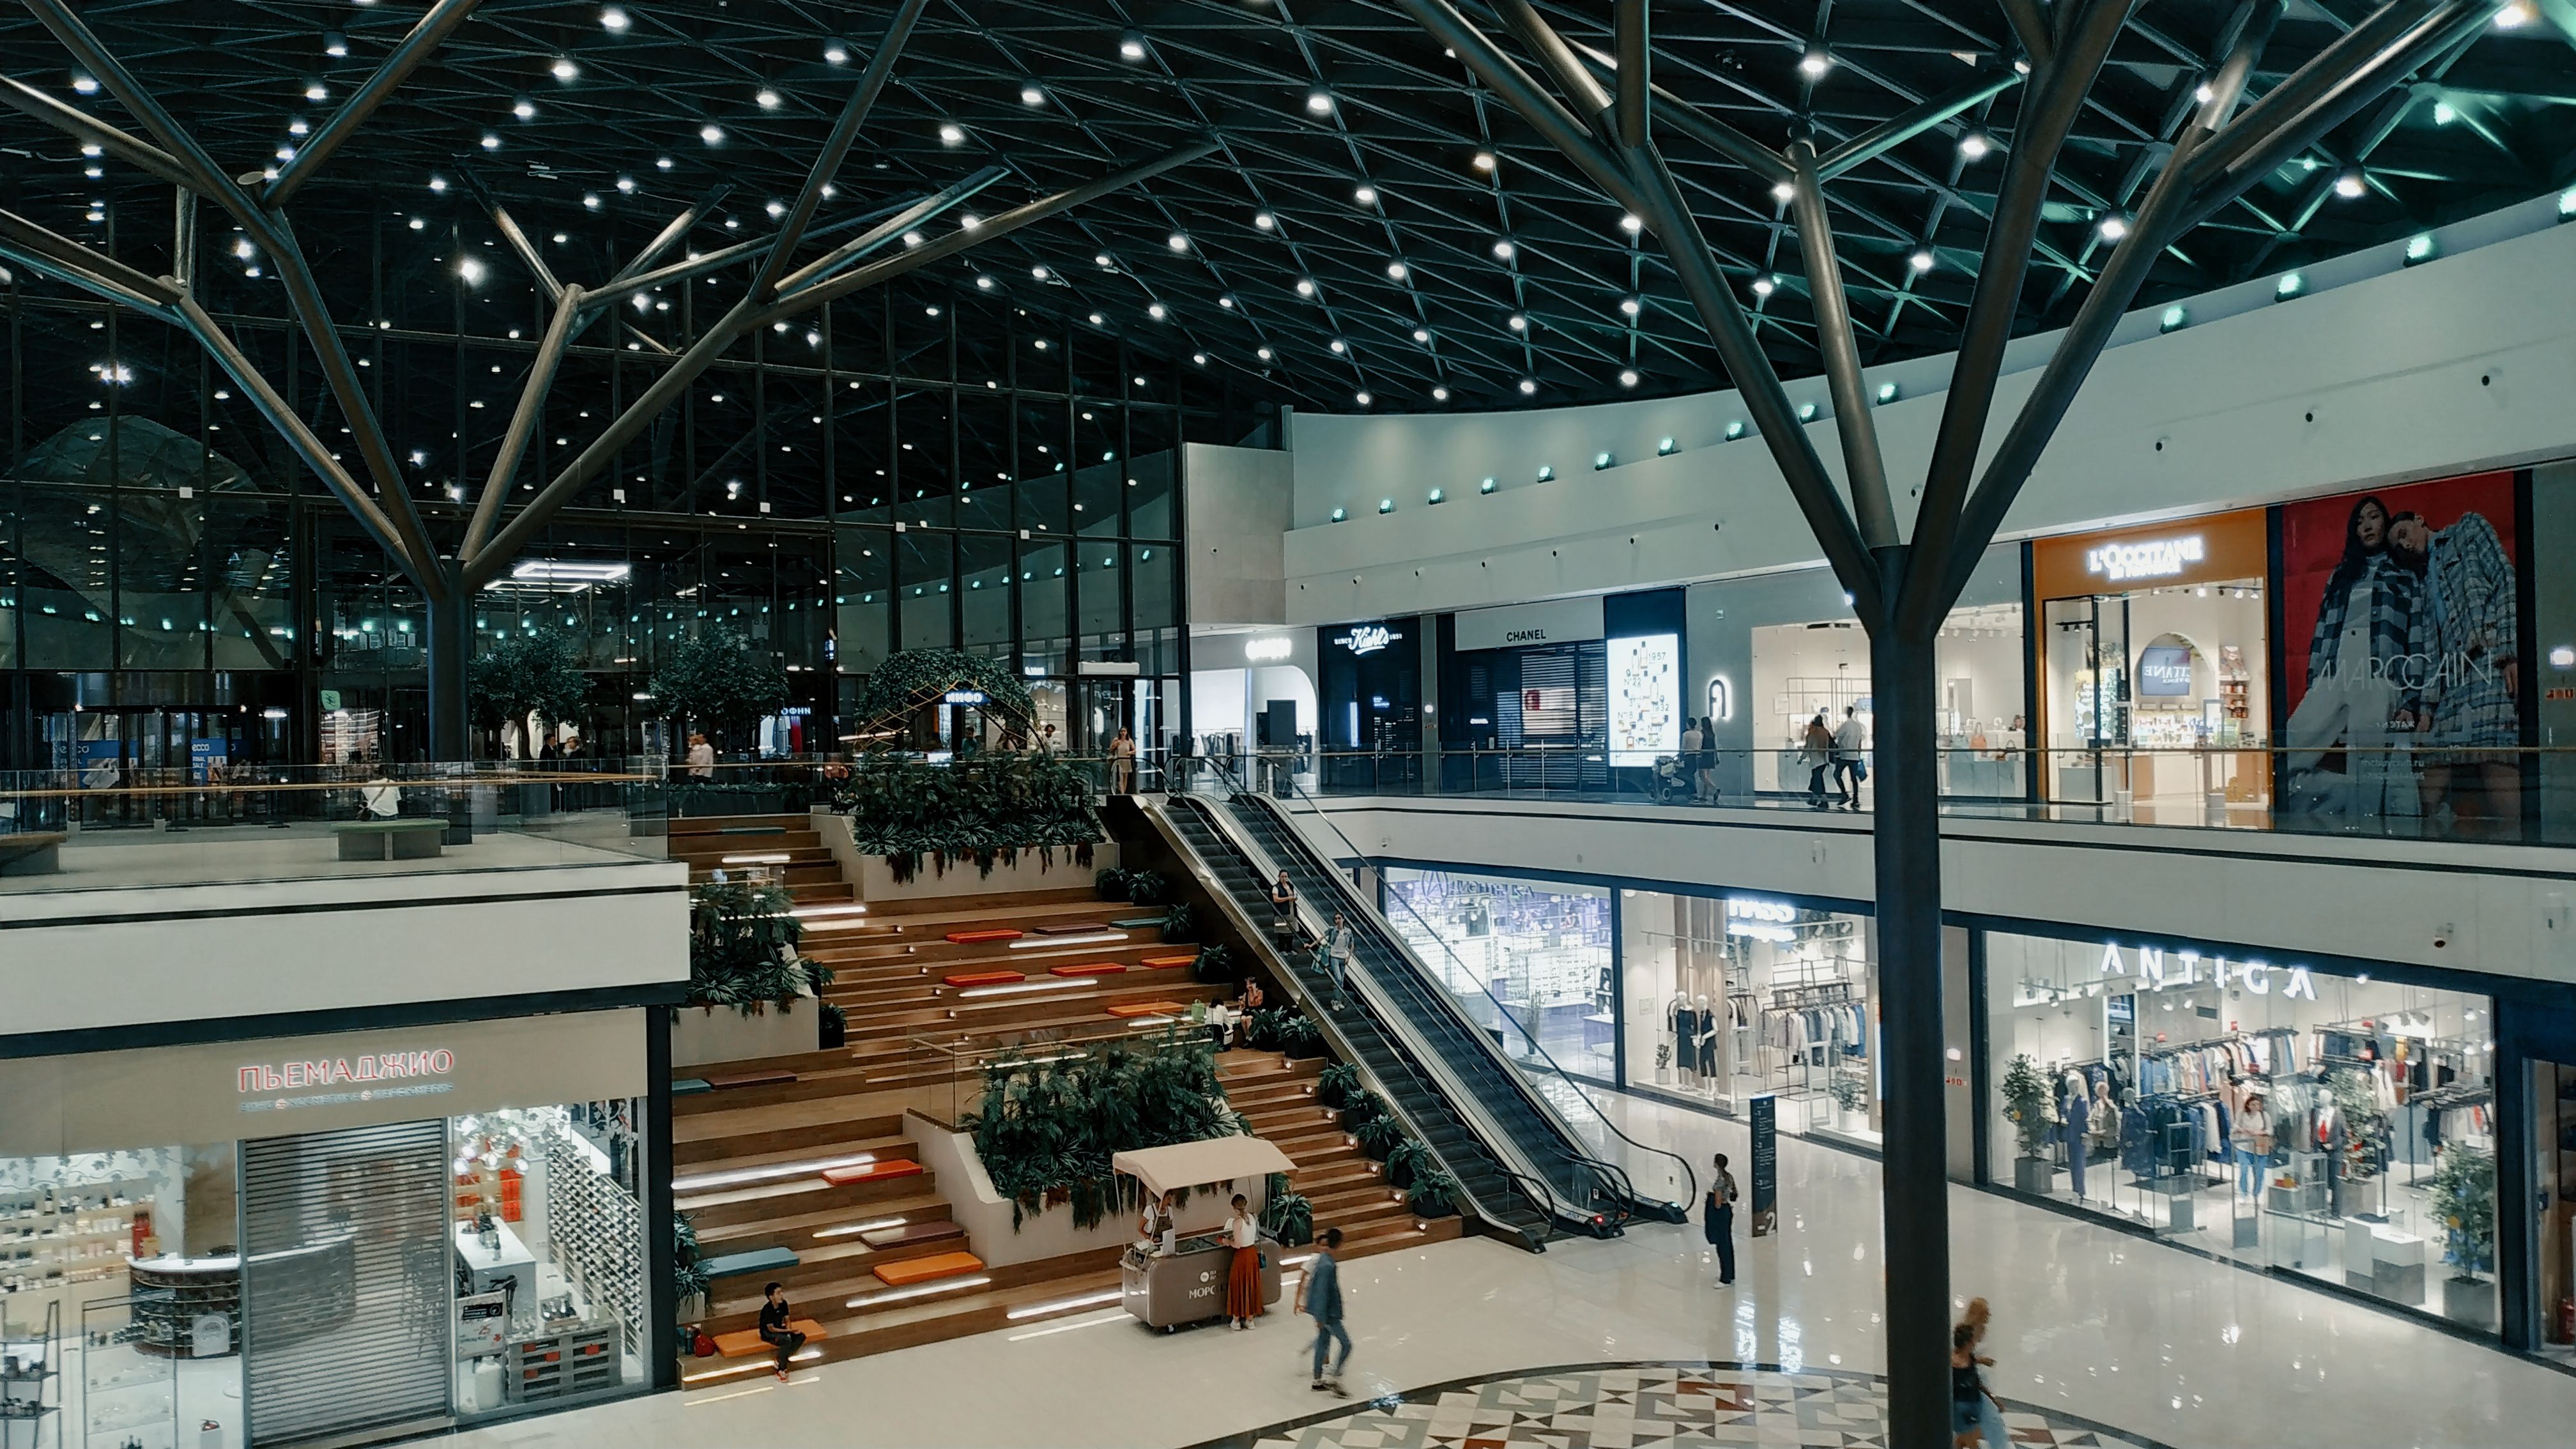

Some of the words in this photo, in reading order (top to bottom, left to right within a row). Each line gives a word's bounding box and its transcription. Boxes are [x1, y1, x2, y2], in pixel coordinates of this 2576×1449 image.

[2089, 536, 2202, 571] L'OCCITANE
[1348, 626, 1389, 650] Kiehl's
[1506, 629, 1546, 642] CHANEL
[1649, 652, 1666, 661] 1957
[192, 743, 210, 752] ecco
[2101, 943, 2318, 1001] ANTIGA
[238, 1049, 454, 1093] ПЬЕМАДЖИО
